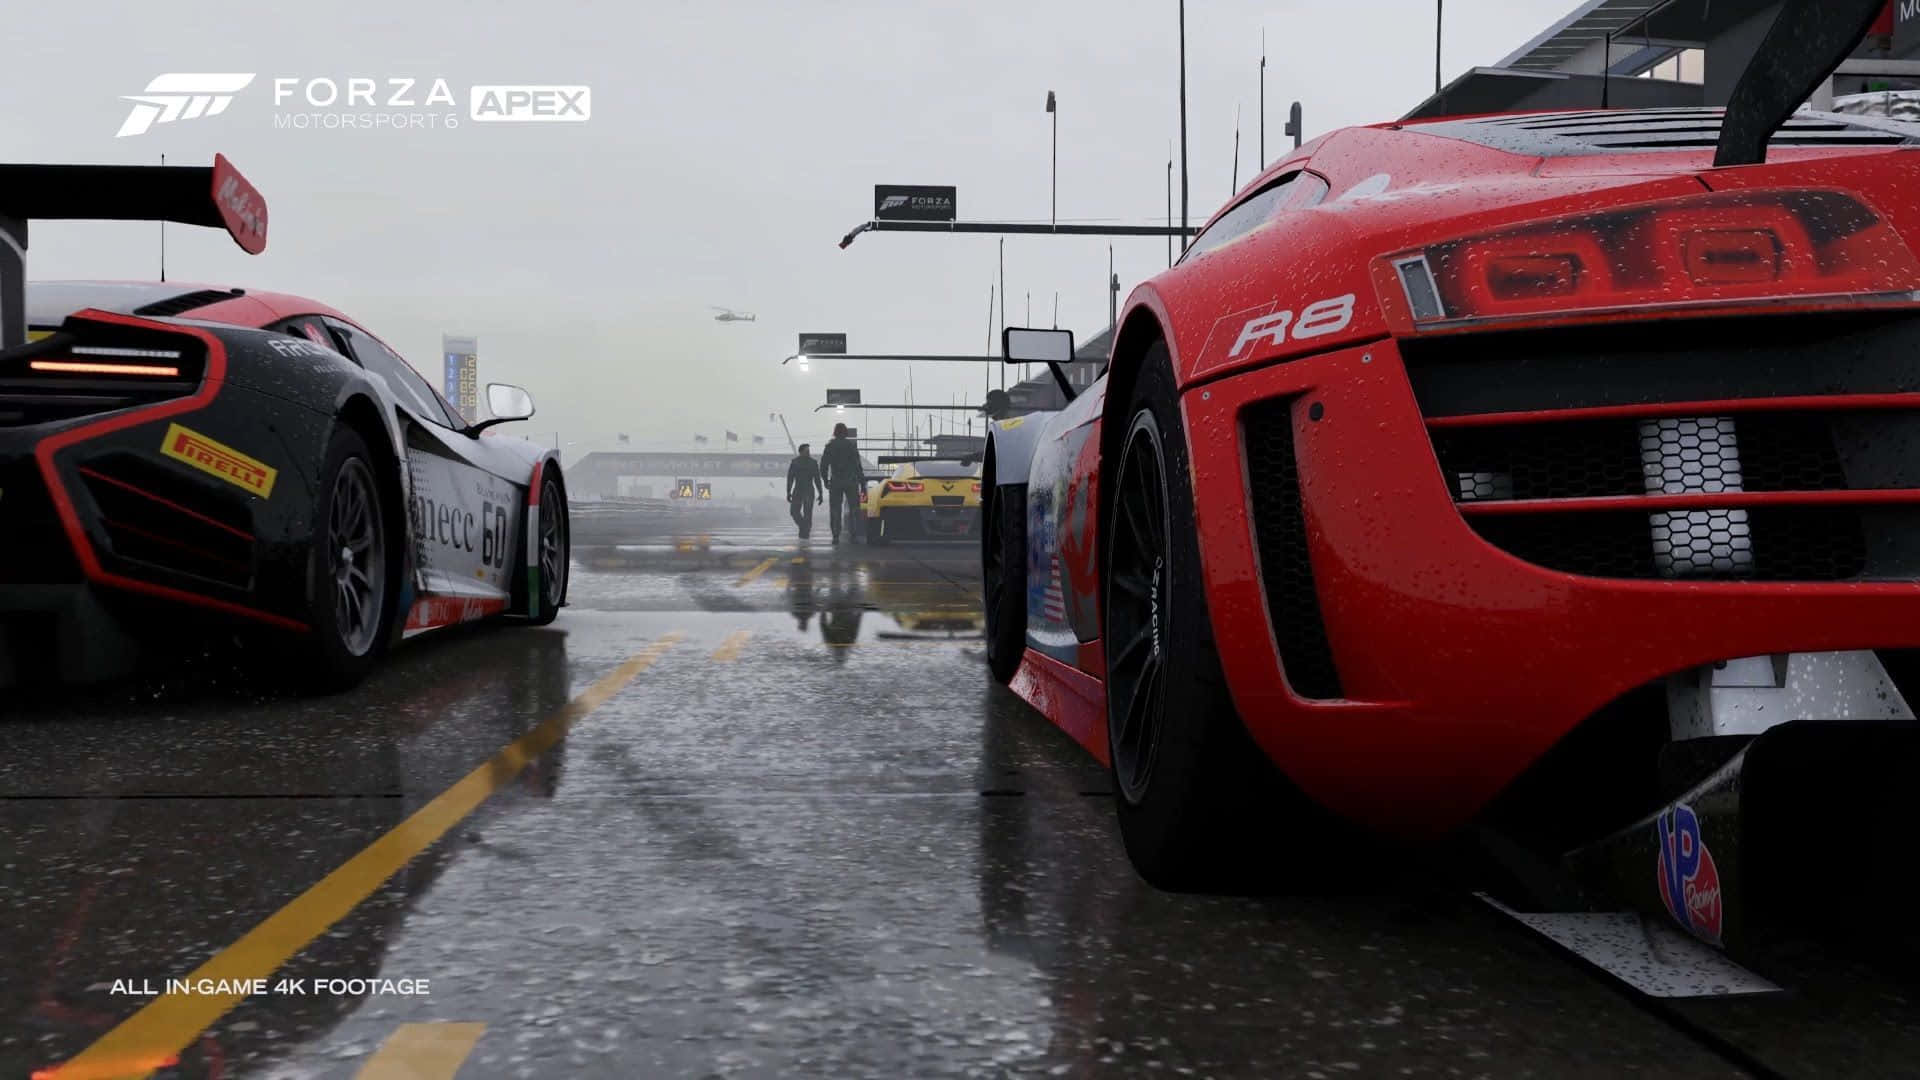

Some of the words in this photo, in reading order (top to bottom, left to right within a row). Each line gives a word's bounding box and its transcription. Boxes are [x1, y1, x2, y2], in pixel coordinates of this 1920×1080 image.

[911, 196, 952, 205] FORZA
[1228, 292, 1356, 358] R8
[172, 431, 268, 489] PIRELLI
[481, 500, 507, 570] 60
[1657, 800, 1701, 932] VP
[1685, 879, 1720, 924] Racing
